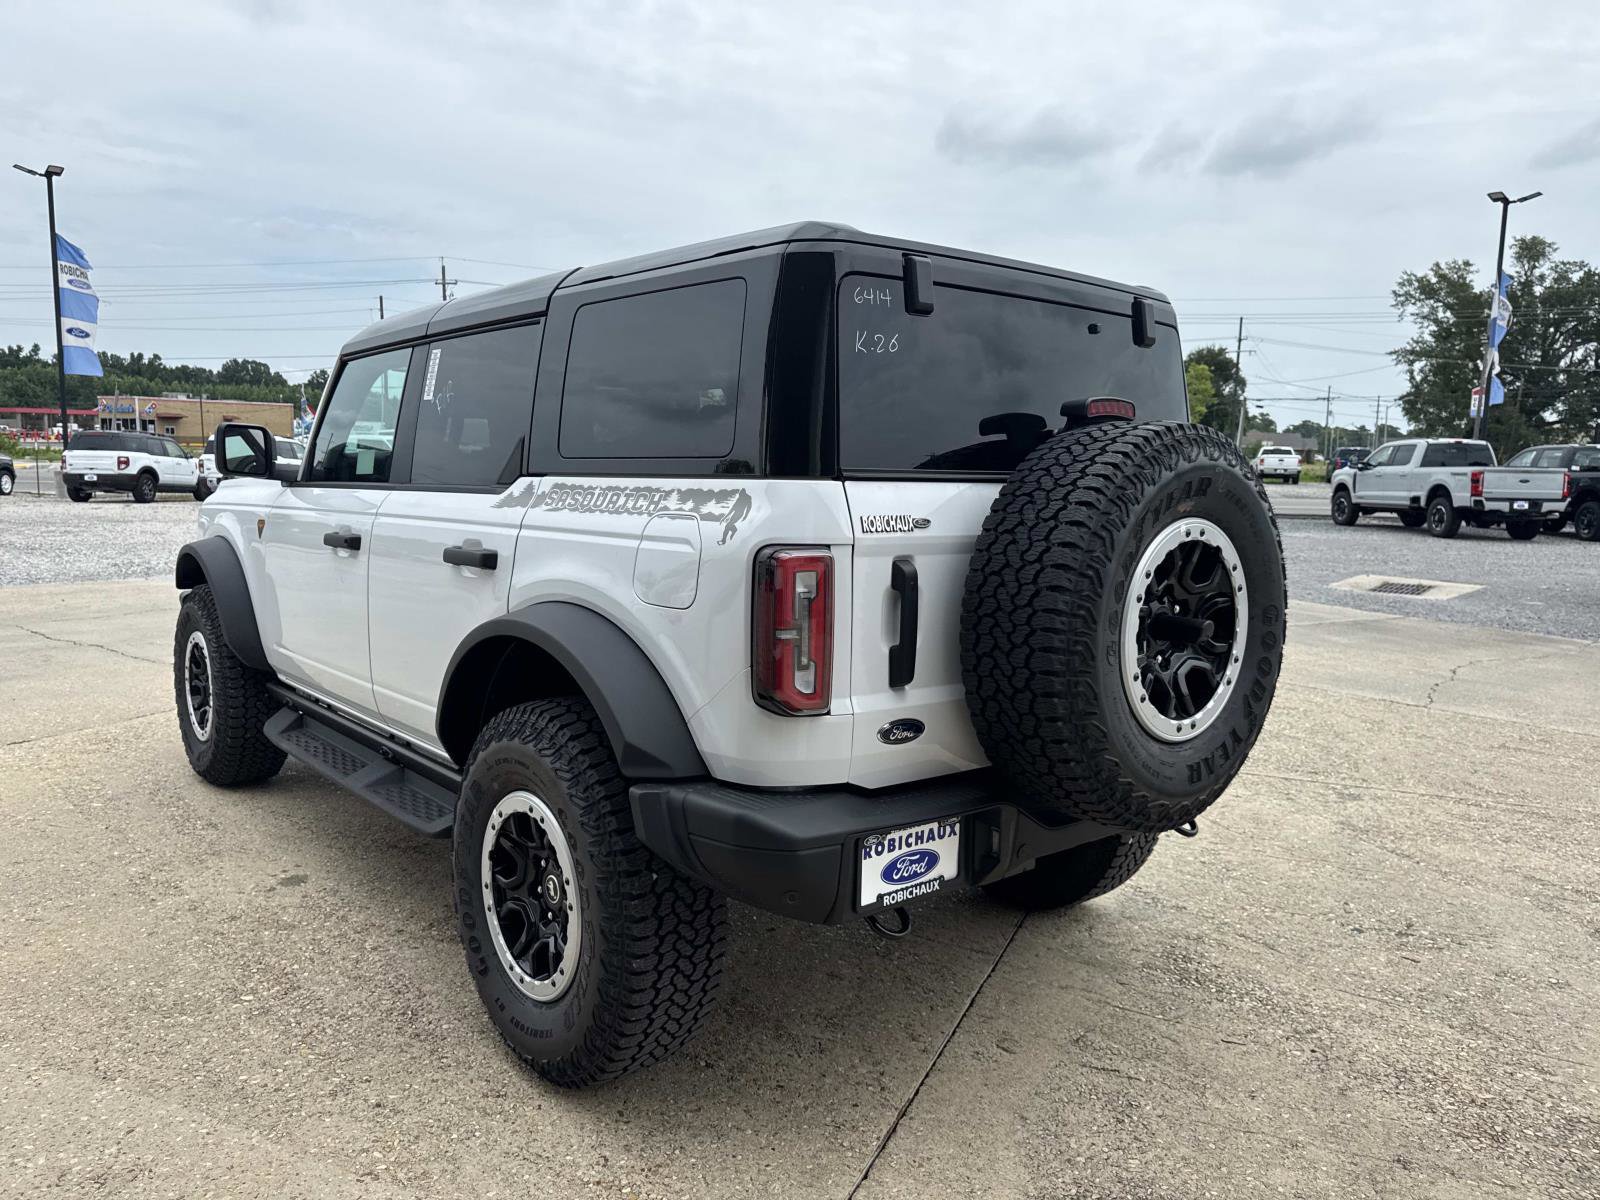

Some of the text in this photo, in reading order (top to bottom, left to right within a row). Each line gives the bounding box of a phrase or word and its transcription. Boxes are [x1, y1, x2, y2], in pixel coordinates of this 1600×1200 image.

[854, 286, 892, 307] 6414
[543, 488, 665, 514] SASQUATCH
[860, 514, 915, 533] ROBICHAUX
[863, 823, 958, 860] ROBICHAUX
[892, 854, 929, 880] Ford
[883, 880, 940, 907] ROBICHAUX
